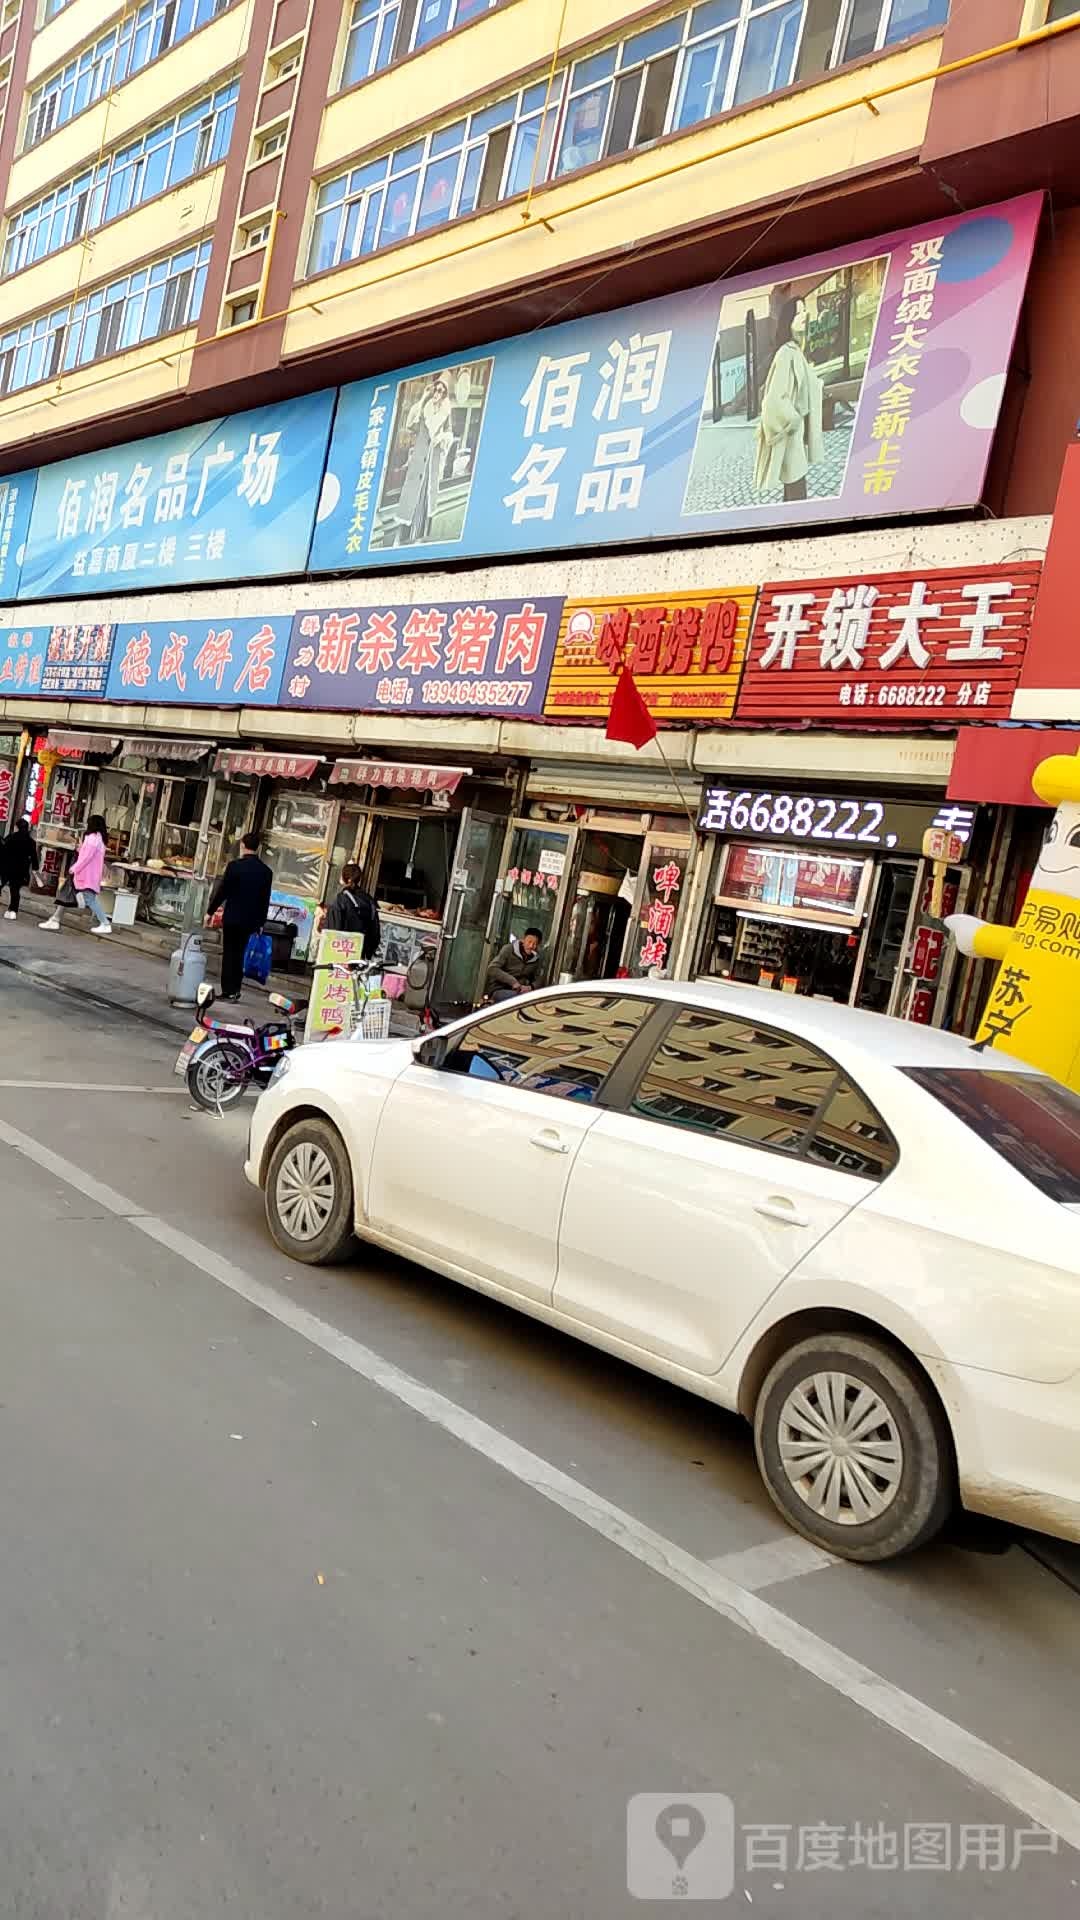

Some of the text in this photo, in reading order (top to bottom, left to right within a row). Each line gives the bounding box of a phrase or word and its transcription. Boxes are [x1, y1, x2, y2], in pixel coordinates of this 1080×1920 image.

[519, 330, 673, 438] 佰润
[863, 235, 945, 496] 双面绒大衣全新上市
[55, 431, 283, 541] 佰润名品广场
[344, 384, 390, 553] 厂家直销皮毛大衣
[502, 426, 647, 524] 名品
[288, 614, 321, 698] 群力村
[314, 603, 548, 675] 新杀笨猪肉
[596, 599, 740, 675] 啤酒烤鸭
[758, 581, 1013, 671] 开锁大王
[422, 680, 532, 706] 13946435277
[956, 681, 992, 705] 分店
